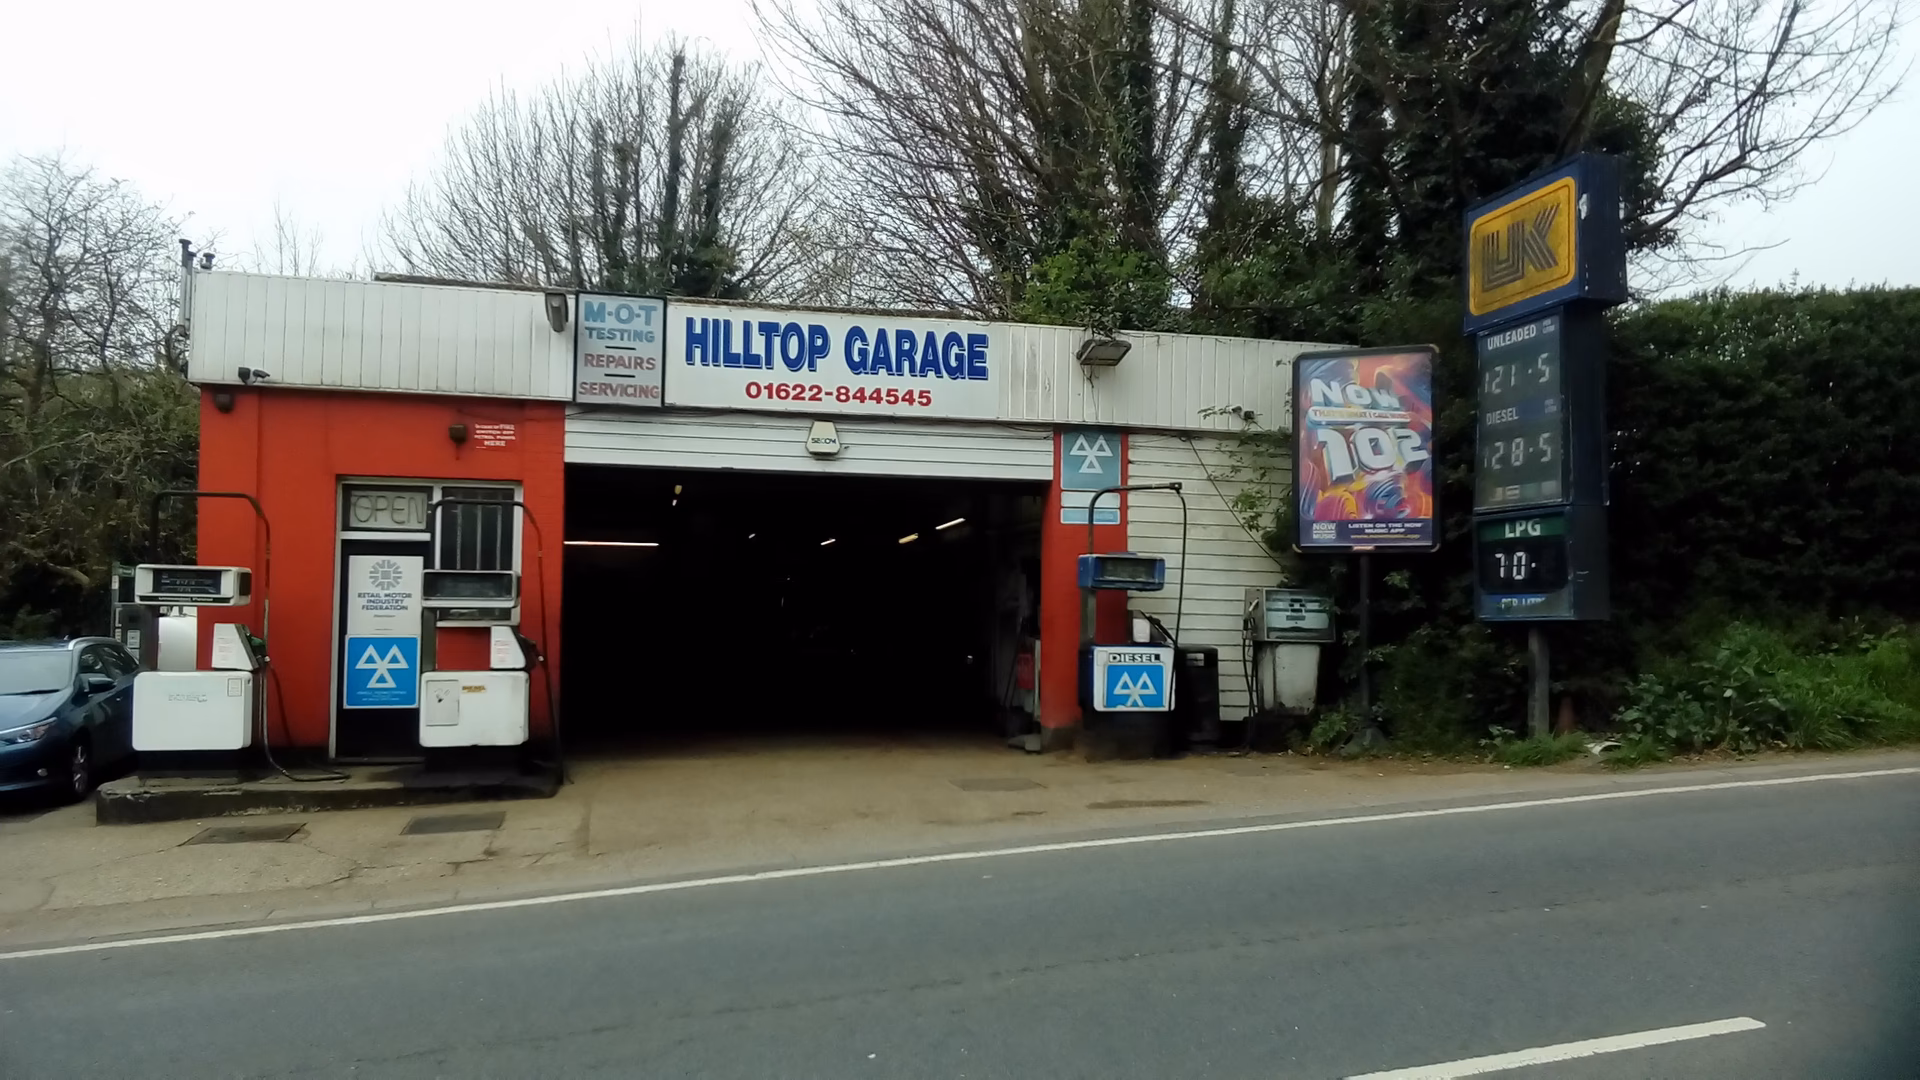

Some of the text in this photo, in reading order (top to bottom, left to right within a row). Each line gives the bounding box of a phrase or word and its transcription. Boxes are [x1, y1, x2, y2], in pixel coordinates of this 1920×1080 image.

[1482, 202, 1561, 293] UK
[584, 326, 656, 343] TESTING
[1487, 324, 1537, 351] UNLEADED
[684, 316, 989, 381] HILLTOP GARAGE
[583, 353, 657, 371] REPAIRS
[578, 381, 660, 399] SERVICING
[745, 381, 933, 407] 01622-844545
[1310, 377, 1400, 409] NOW
[1486, 407, 1520, 426] DIESEL
[1317, 427, 1430, 483] 102
[353, 494, 425, 525] OPEN
[1312, 522, 1337, 530] NOW
[1504, 518, 1542, 539] LPG
[1109, 653, 1160, 663] DIESEL
